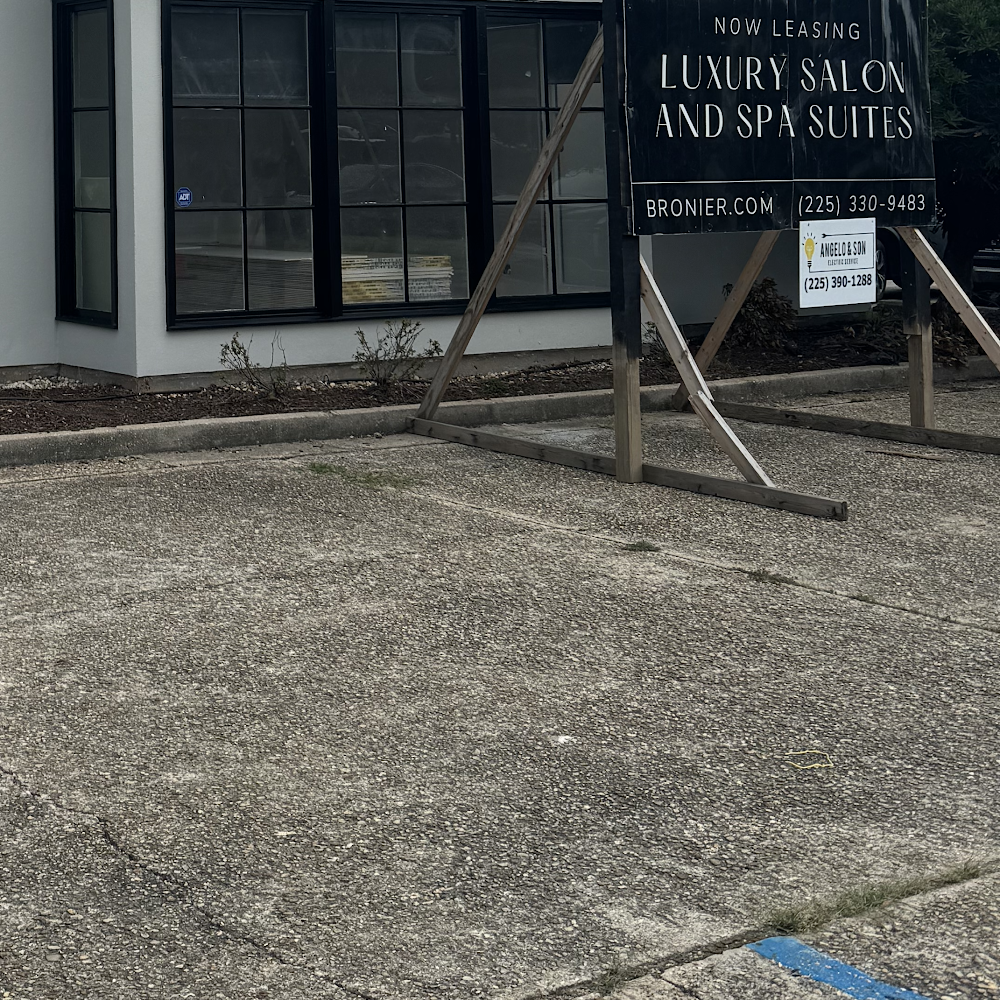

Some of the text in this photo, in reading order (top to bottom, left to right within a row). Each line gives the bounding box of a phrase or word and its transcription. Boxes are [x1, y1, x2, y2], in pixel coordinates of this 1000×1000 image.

[714, 16, 861, 41] NOW LEASING
[660, 54, 906, 94] LUXURY SALON
[655, 103, 914, 140] AND SPA SUITES
[178, 193, 191, 201] ADT
[646, 196, 774, 218] BRONIER.COM
[798, 194, 926, 217] (225) 330-9483
[820, 240, 867, 258] ANGELO & SON
[804, 273, 872, 293] (225) 390-1288
